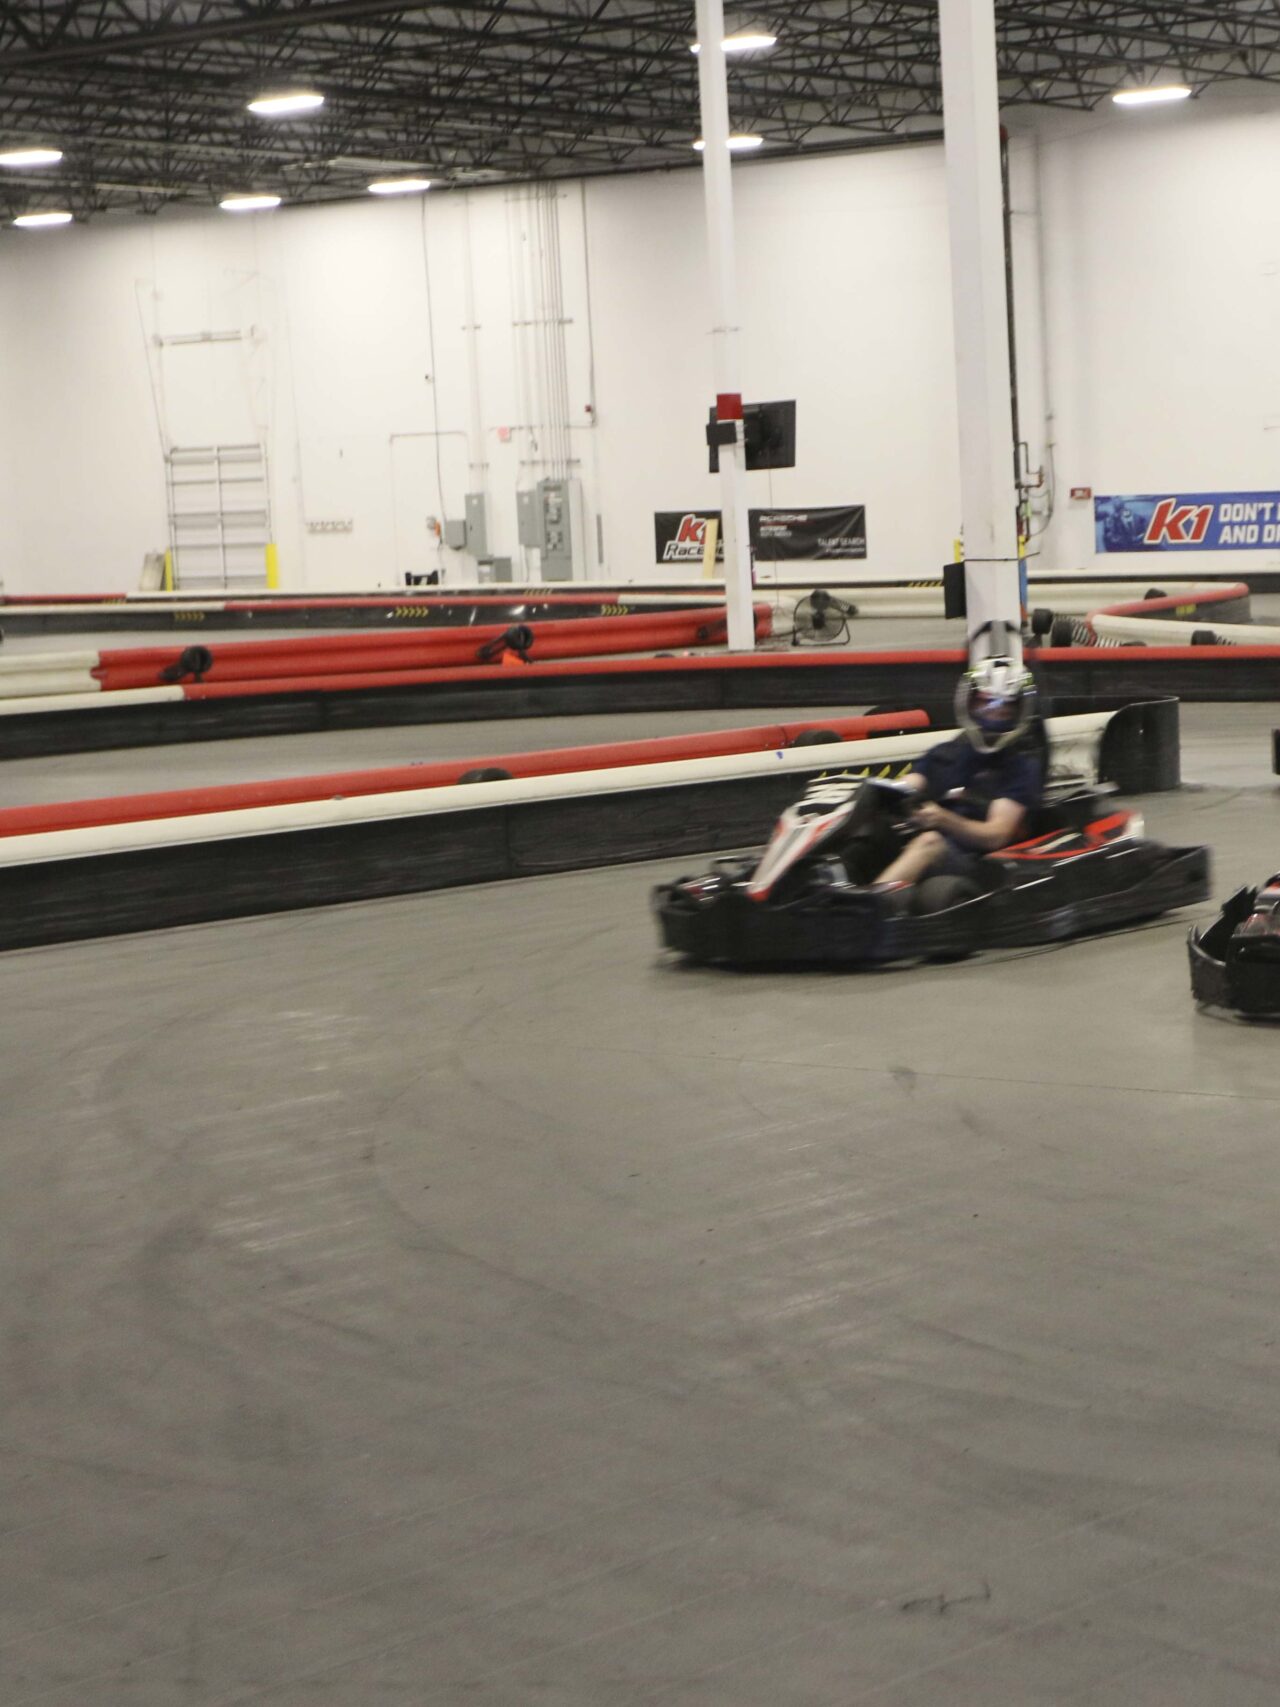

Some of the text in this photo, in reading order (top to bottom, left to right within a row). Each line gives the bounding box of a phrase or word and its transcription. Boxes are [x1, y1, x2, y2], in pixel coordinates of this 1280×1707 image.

[1143, 497, 1214, 545] K1
[1218, 502, 1275, 523] DON'T
[1218, 524, 1259, 545] AND
